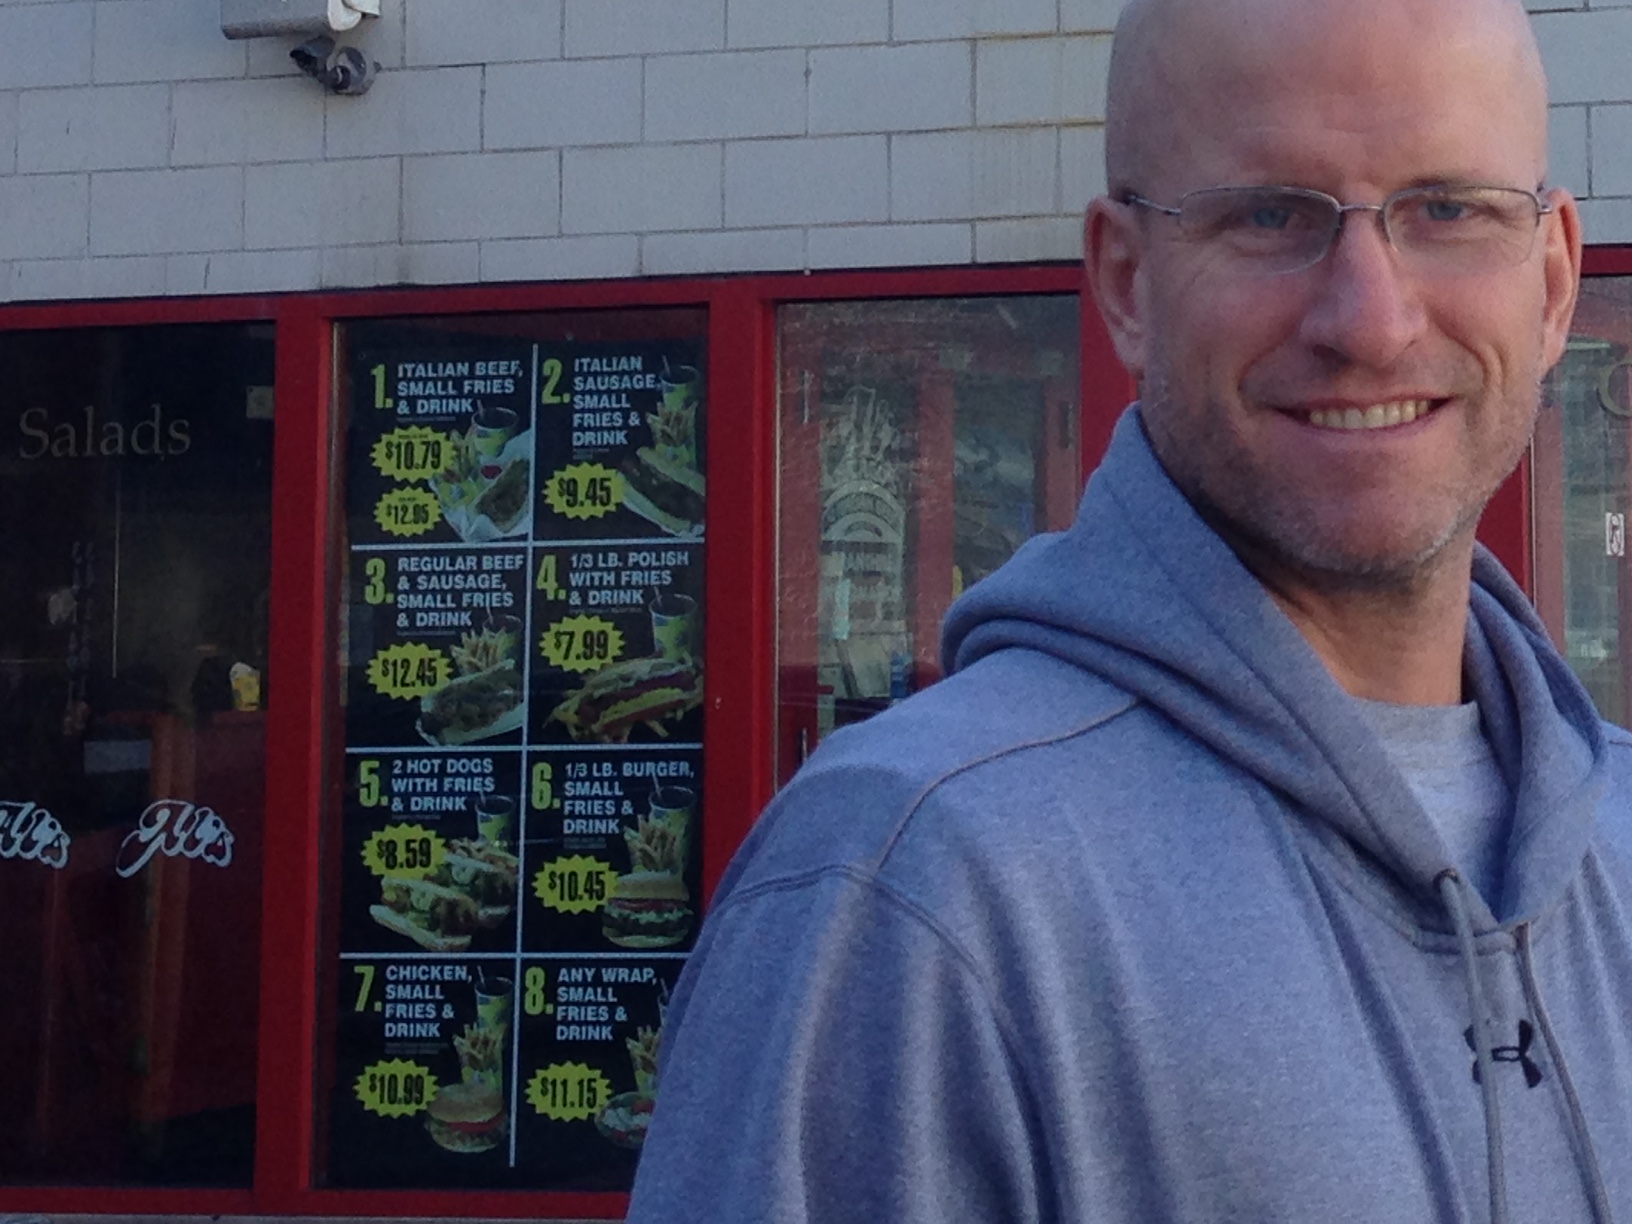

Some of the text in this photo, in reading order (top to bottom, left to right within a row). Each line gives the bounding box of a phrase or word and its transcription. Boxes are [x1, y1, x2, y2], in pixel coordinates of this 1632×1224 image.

[397, 359, 524, 378] ITALIAN BEEF,
[574, 355, 643, 372] ITALIAN
[370, 363, 394, 410] 1.
[396, 378, 516, 397] SMALL FRIES
[542, 358, 571, 405] 2.
[396, 397, 474, 415] & DRINK
[573, 393, 631, 409] SMALL
[573, 411, 641, 428] FRIES &
[18, 403, 193, 461] Salads
[572, 429, 629, 446] DRINK
[385, 440, 442, 470] $10.79
[557, 477, 612, 508] $9.45
[397, 554, 524, 572] REGULAR BEEF
[570, 551, 689, 569] 1/3 LB. POLISH
[364, 557, 395, 604] 3.
[397, 573, 507, 591] & SAUSAGE,
[536, 554, 567, 600] 4.
[569, 569, 672, 587] WITH FRIES
[396, 592, 514, 609] SMALL FRIES
[569, 589, 644, 606] & DRINK
[396, 610, 473, 627] & DRINK
[554, 630, 609, 661] $7.99
[381, 657, 437, 688] $12.45
[392, 757, 494, 774] 2 HOT DOGS
[565, 761, 695, 779] 1/3 LB. BURGER,
[358, 759, 389, 807] 5.
[391, 776, 495, 793] WITH FRIES
[531, 761, 561, 810] 6.
[563, 781, 624, 797] SMALL
[391, 796, 467, 812] & DRINK
[563, 799, 635, 815] FRIES &
[563, 818, 620, 834] DRINK
[377, 837, 431, 870] $8.59
[548, 870, 605, 902] $10.45
[385, 964, 473, 983] CHICKEN,
[557, 967, 657, 986] ANY WRAP,
[353, 964, 382, 1012] 7.
[385, 984, 445, 1000] SMALL
[524, 966, 554, 1016] 8.
[556, 986, 618, 1003] SMALL
[385, 1002, 456, 1019] FRIES &
[556, 1005, 629, 1022] FRIES &
[384, 1022, 441, 1038] DRINK
[555, 1024, 615, 1041] DRINK
[369, 1073, 424, 1105] $10.99
[540, 1076, 596, 1109] $11.15
